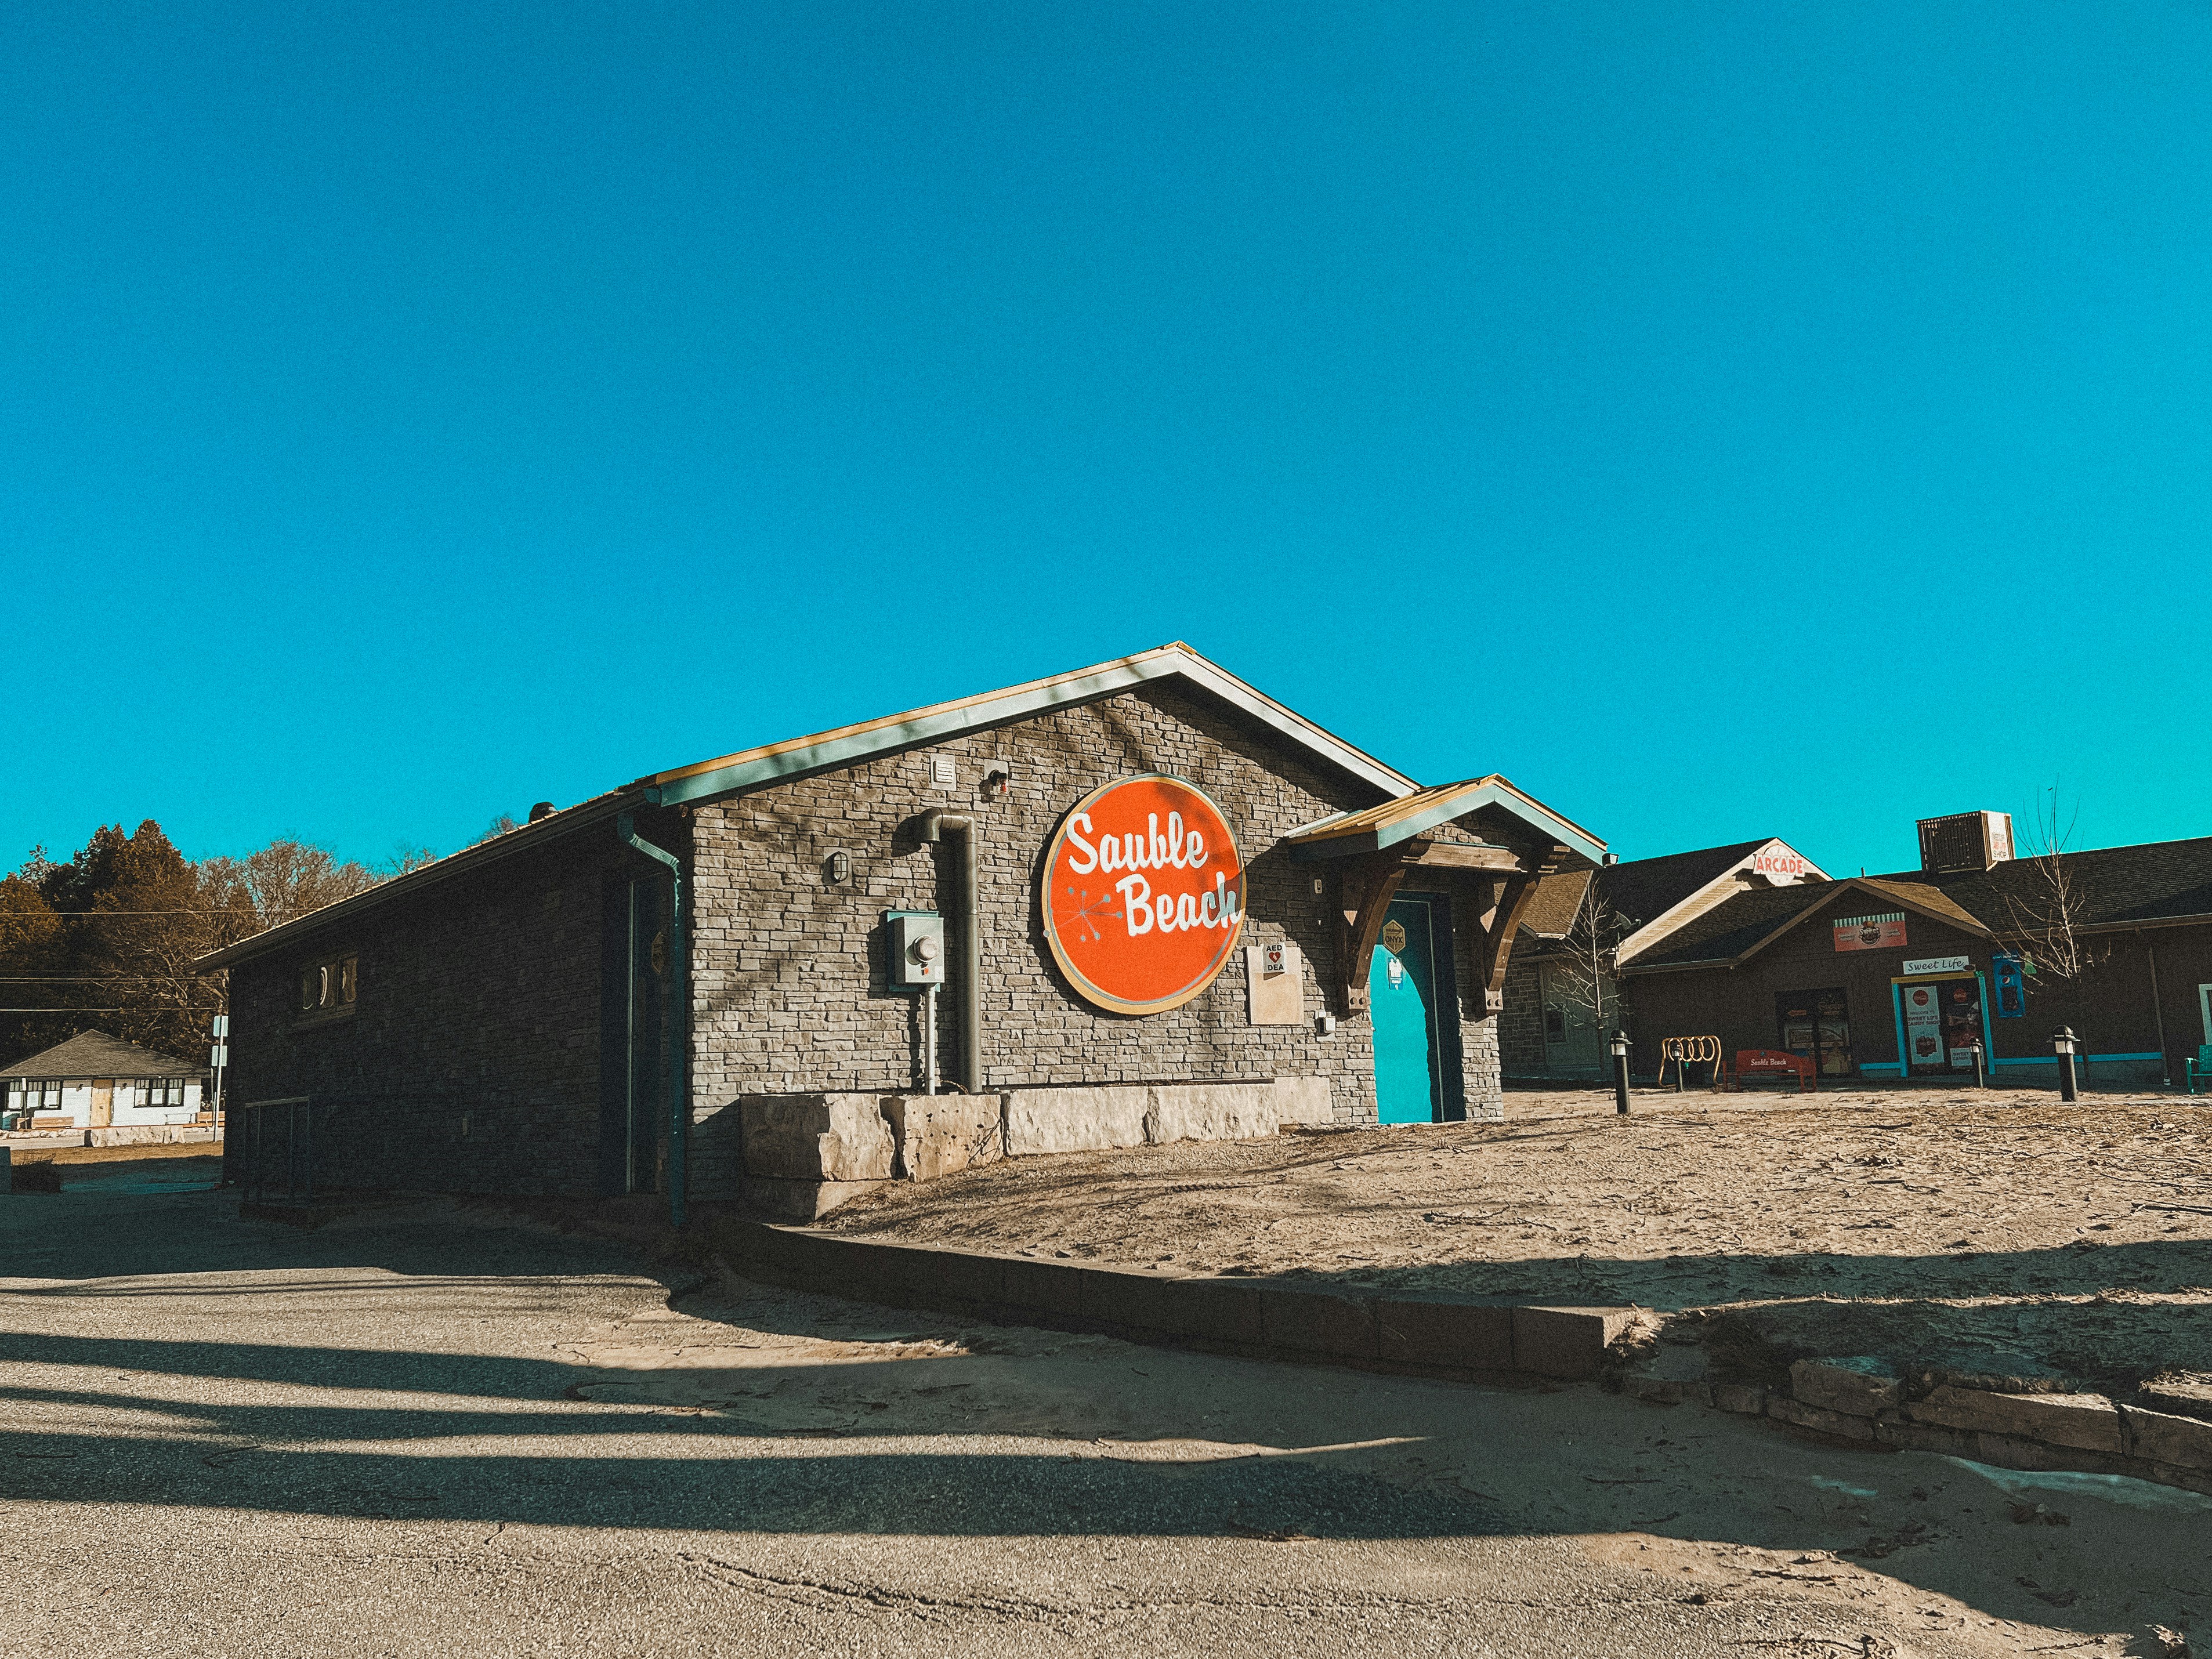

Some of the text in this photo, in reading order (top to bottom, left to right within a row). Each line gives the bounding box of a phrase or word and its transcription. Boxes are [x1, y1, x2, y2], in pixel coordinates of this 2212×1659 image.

[1066, 811, 1208, 874] Sauble
[1756, 857, 1803, 874] ARCADE
[1115, 871, 1242, 937] Beach
[1385, 936, 1403, 944] ONYX
[1907, 958, 1964, 972] Sweet Life
[1750, 1057, 1787, 1066] Sauble Beach
